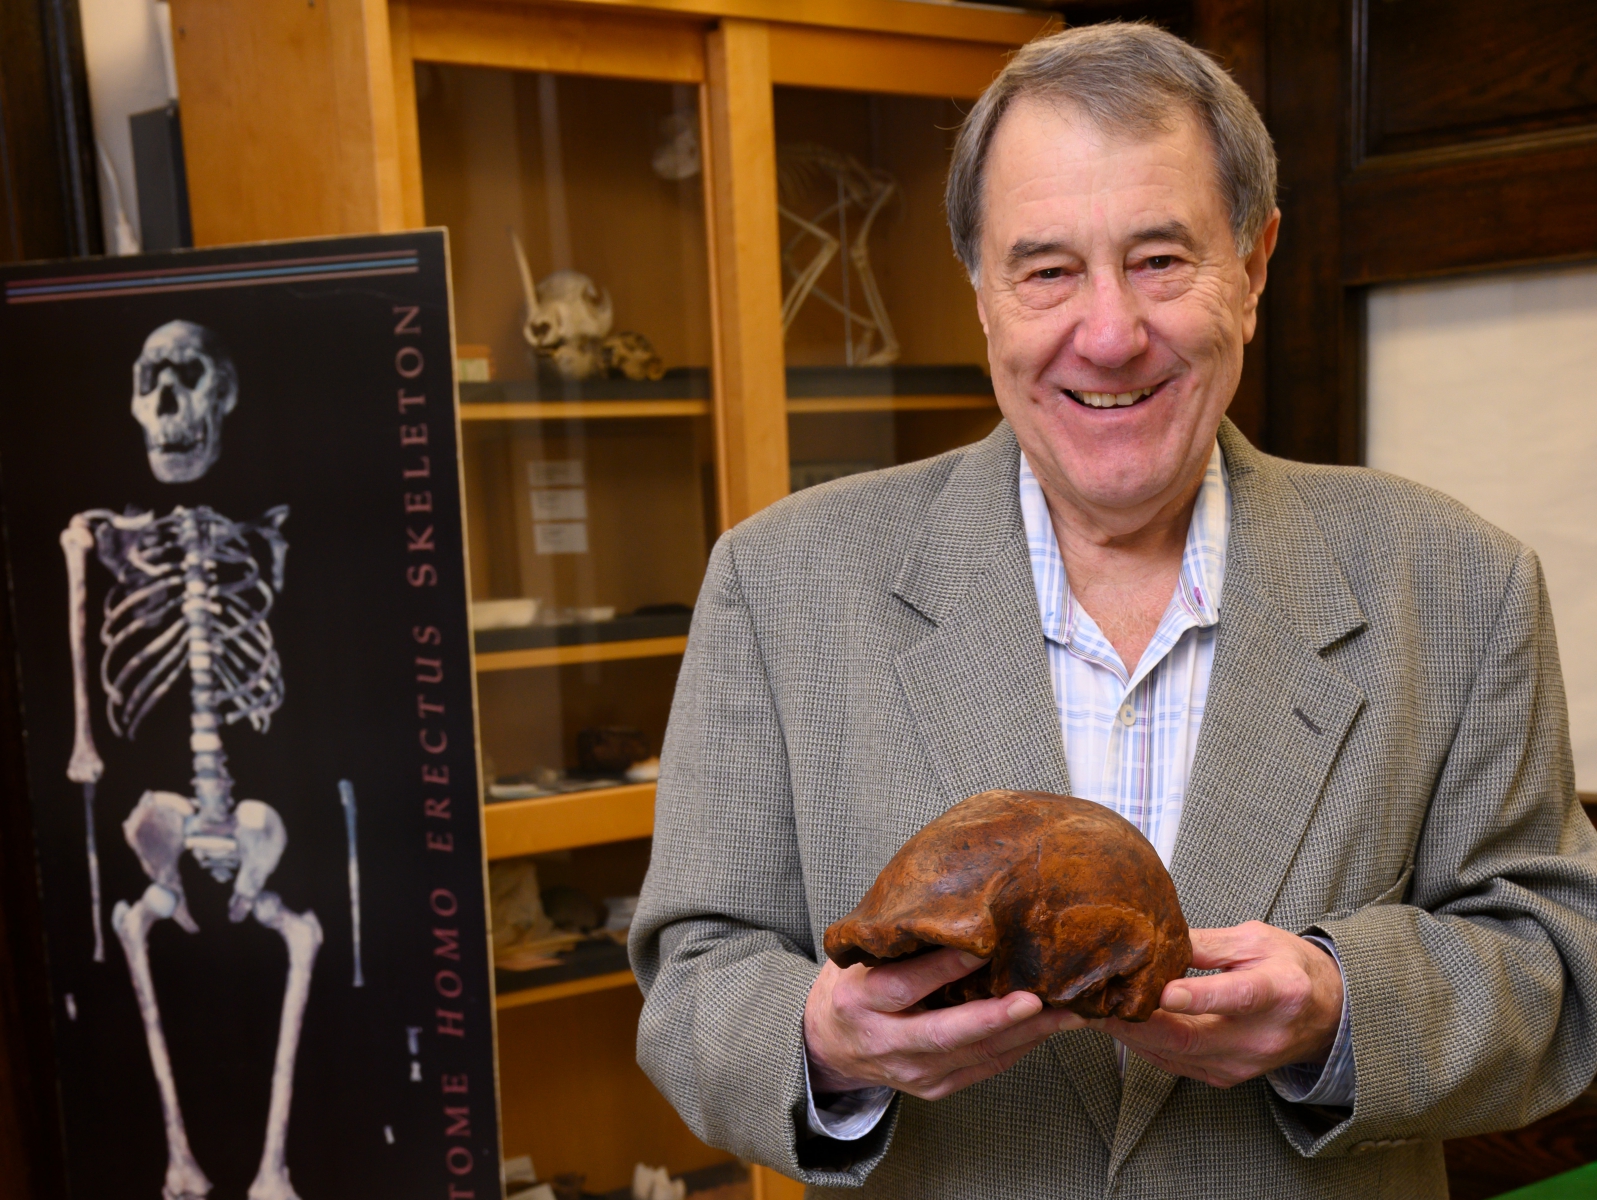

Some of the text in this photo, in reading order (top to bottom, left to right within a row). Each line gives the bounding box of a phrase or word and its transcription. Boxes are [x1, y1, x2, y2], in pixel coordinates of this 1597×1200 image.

[392, 304, 438, 587] SKELETON
[412, 625, 455, 852] ERECTUS
[429, 888, 466, 1038] HOMO
